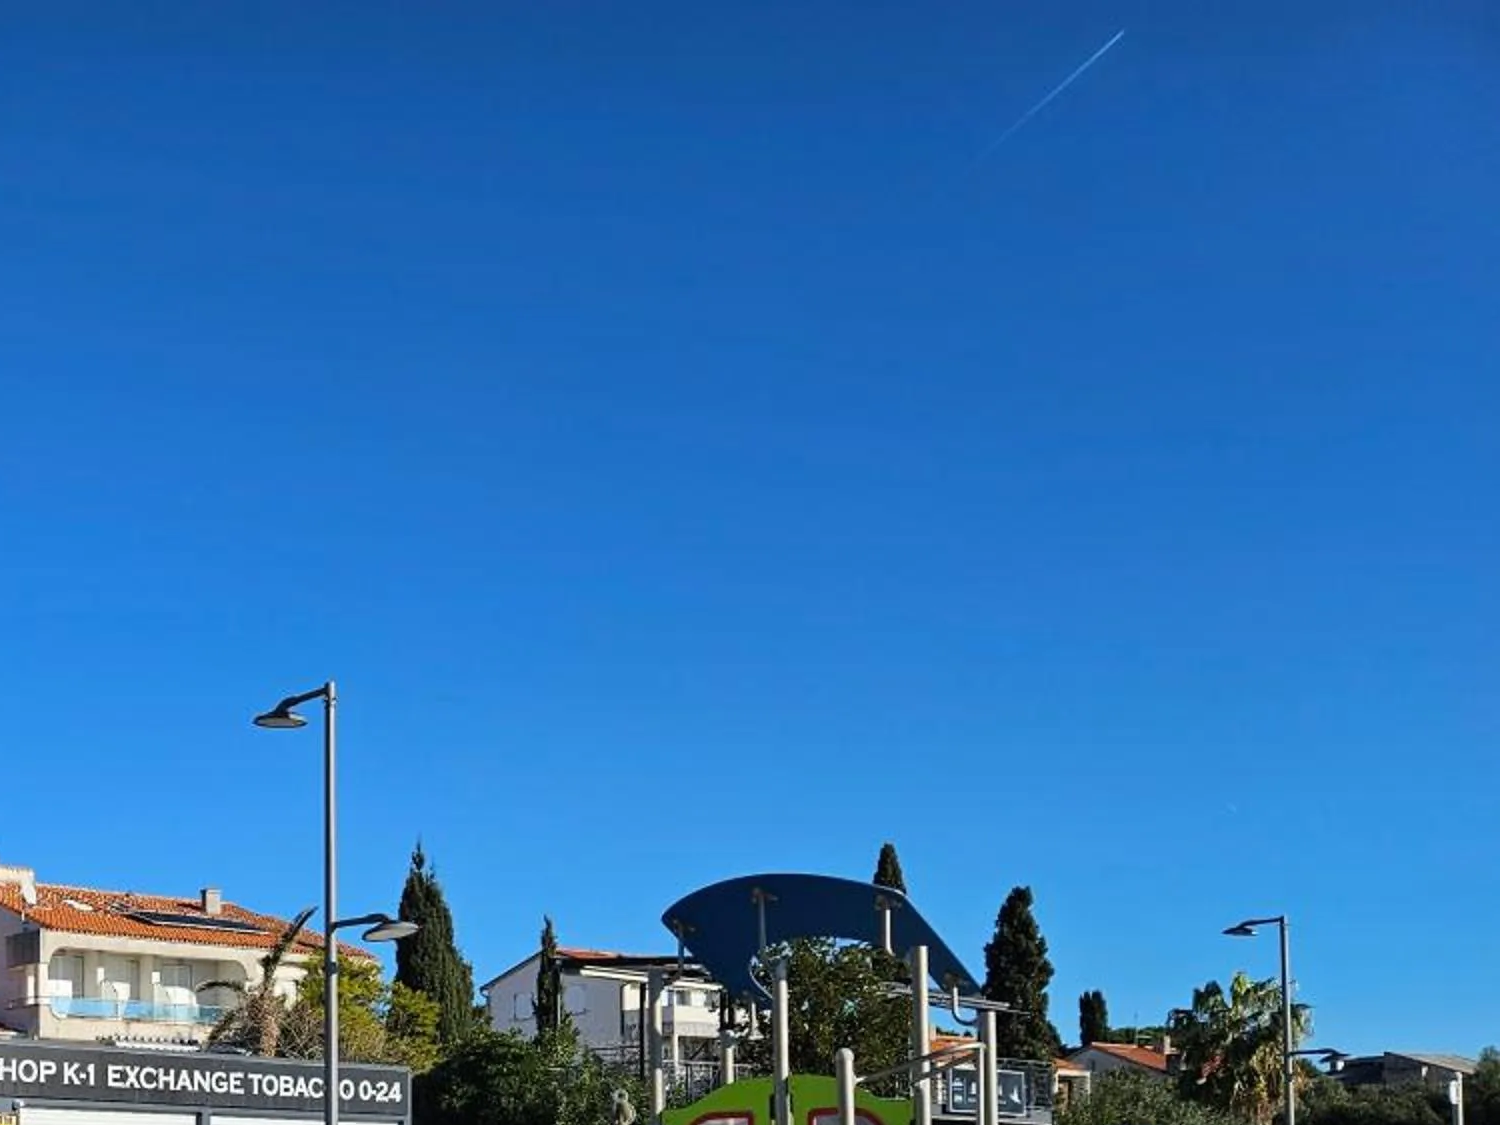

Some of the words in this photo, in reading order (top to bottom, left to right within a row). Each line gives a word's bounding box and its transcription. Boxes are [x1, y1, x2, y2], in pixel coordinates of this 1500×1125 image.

[62, 1062, 96, 1086] K-1
[107, 1063, 245, 1095] EXCHANGE
[248, 1073, 355, 1101] TOBACO
[358, 1080, 402, 1103] 0-24
